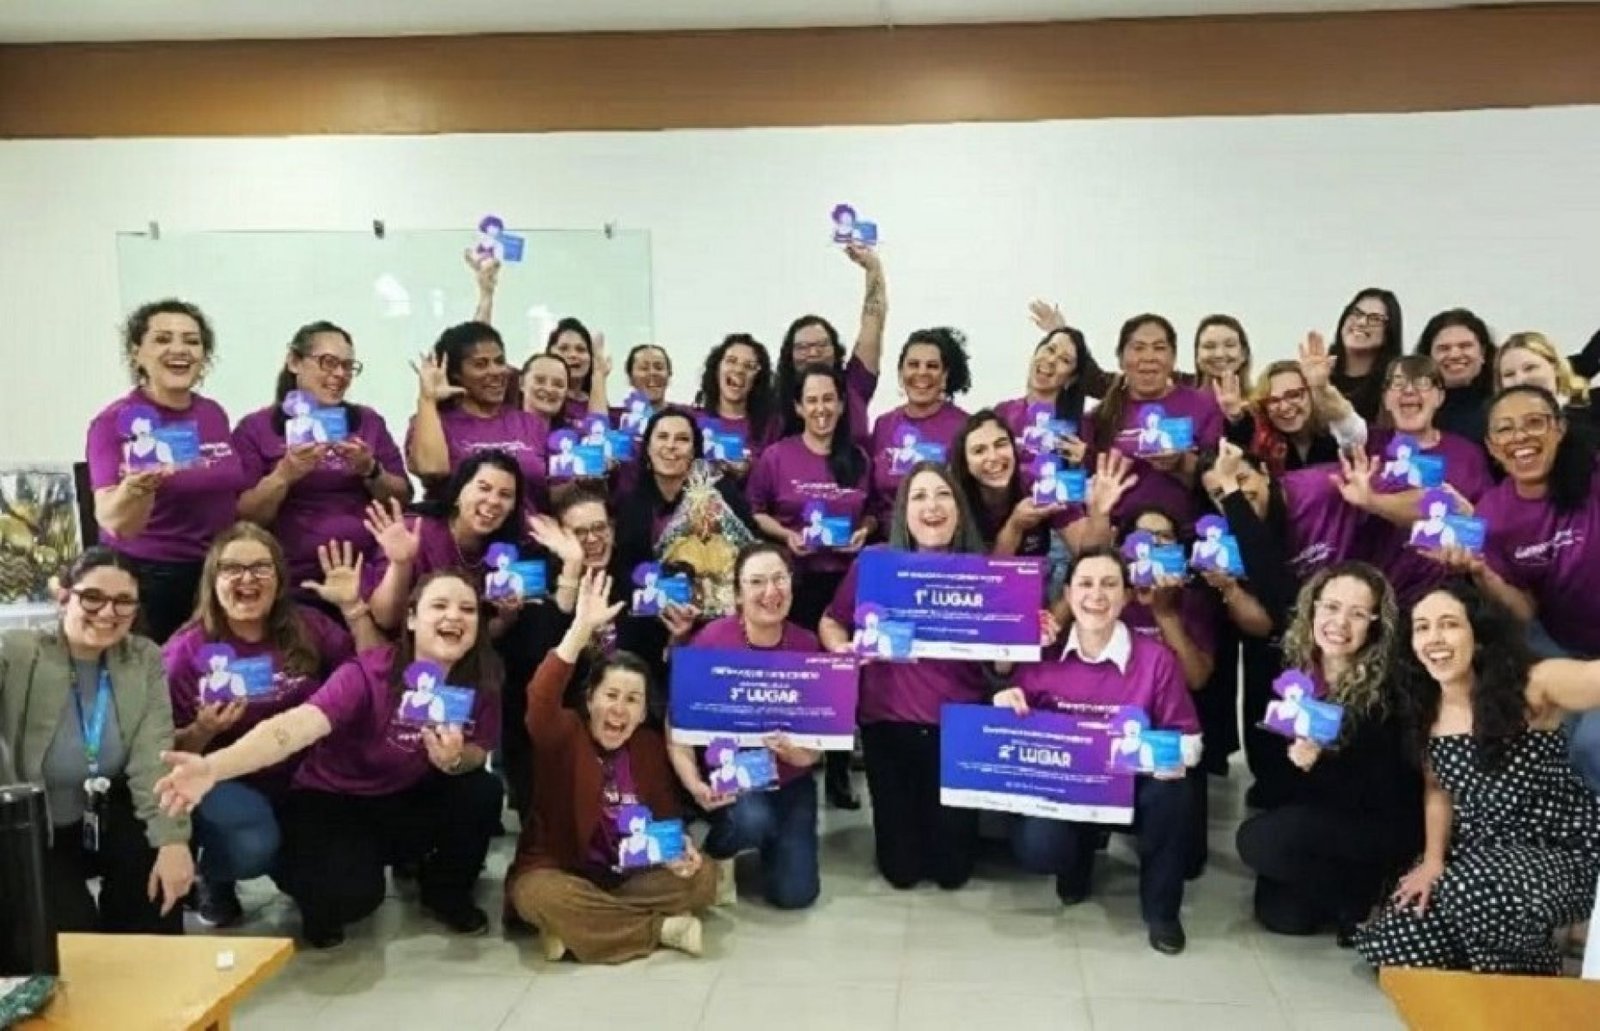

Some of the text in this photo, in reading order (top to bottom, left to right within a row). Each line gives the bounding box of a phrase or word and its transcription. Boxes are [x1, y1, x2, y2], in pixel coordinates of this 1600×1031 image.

[931, 590, 984, 607] LUGAR
[746, 687, 798, 703] LUGAR
[1019, 746, 1072, 767] LUGAR
